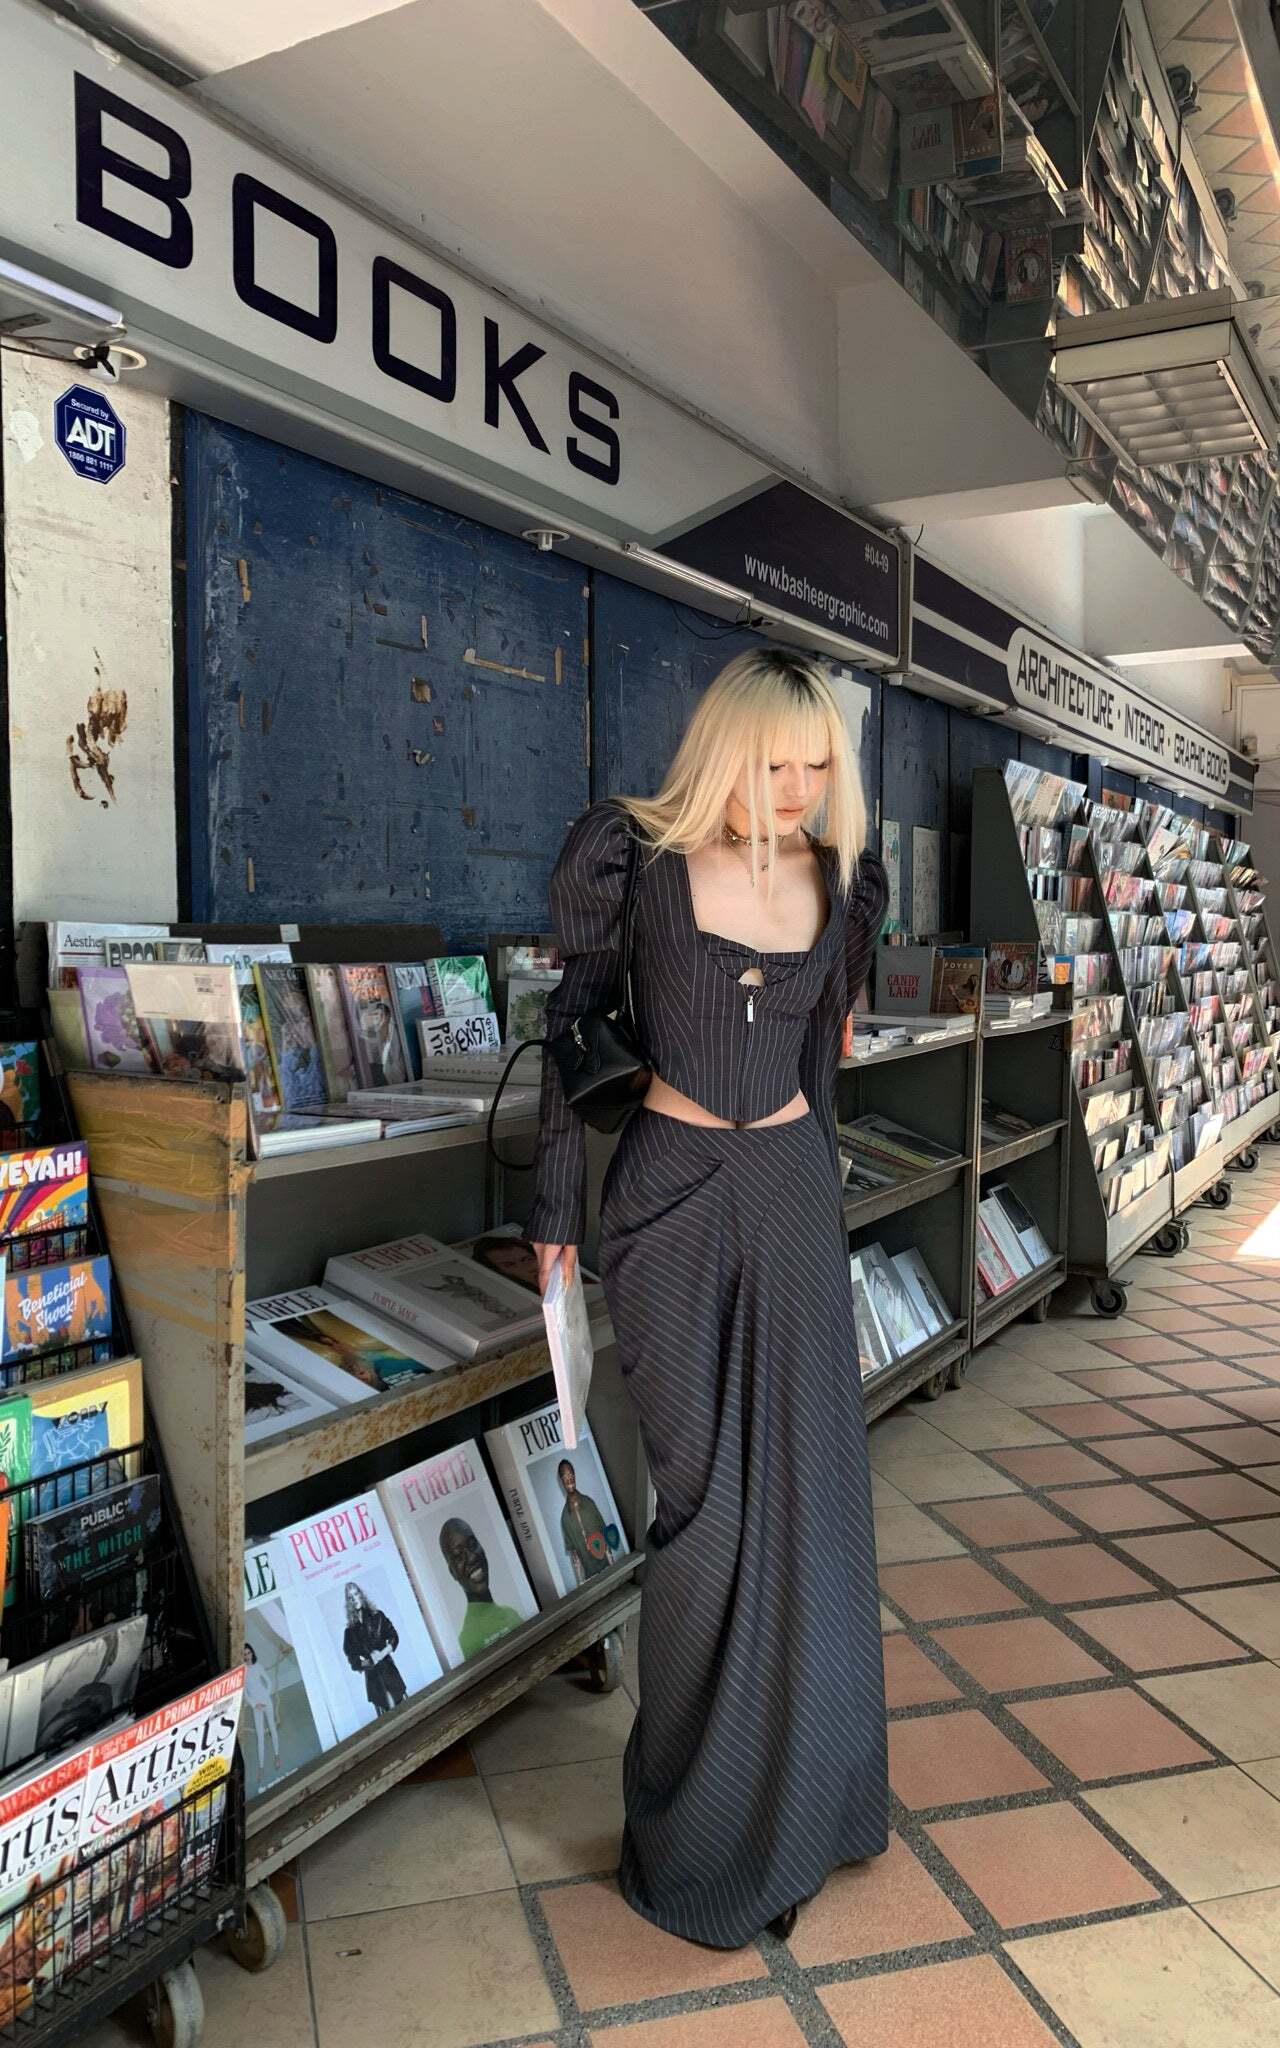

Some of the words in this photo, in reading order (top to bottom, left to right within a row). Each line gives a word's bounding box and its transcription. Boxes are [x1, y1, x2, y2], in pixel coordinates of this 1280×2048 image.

[74, 70, 620, 486] BOOKS
[71, 398, 100, 415] Secured
[100, 408, 109, 420] by
[66, 416, 115, 456] ADT
[865, 544, 889, 574] #04-19
[744, 553, 889, 640] www.basheergraphic.com
[1016, 644, 1115, 731] ARCHITECTURE
[1124, 703, 1164, 756] INTERIOR
[1174, 733, 1205, 775] GRAPHIC
[1206, 751, 1227, 785] BOOKS
[64, 934, 104, 949] Aesthe
[888, 974, 920, 987] CANDY
[888, 987, 918, 998] LAND
[18, 1272, 87, 1320] Beneficial
[36, 1292, 78, 1332] Shock!
[246, 1291, 329, 1321] URPLE
[520, 1408, 562, 1457] PURP
[401, 1450, 475, 1512] PURPLE
[64, 1546, 93, 1573] THE
[97, 1524, 142, 1558] WITCH
[288, 1502, 378, 1571] PURPLE
[136, 1718, 161, 1743] ALLA
[164, 1697, 195, 1729] PRIMA
[198, 1674, 243, 1709] PAINTING
[87, 1715, 236, 1818] Artists
[89, 1804, 112, 1834] &
[115, 1743, 225, 1814] ILLUSTRATORS
